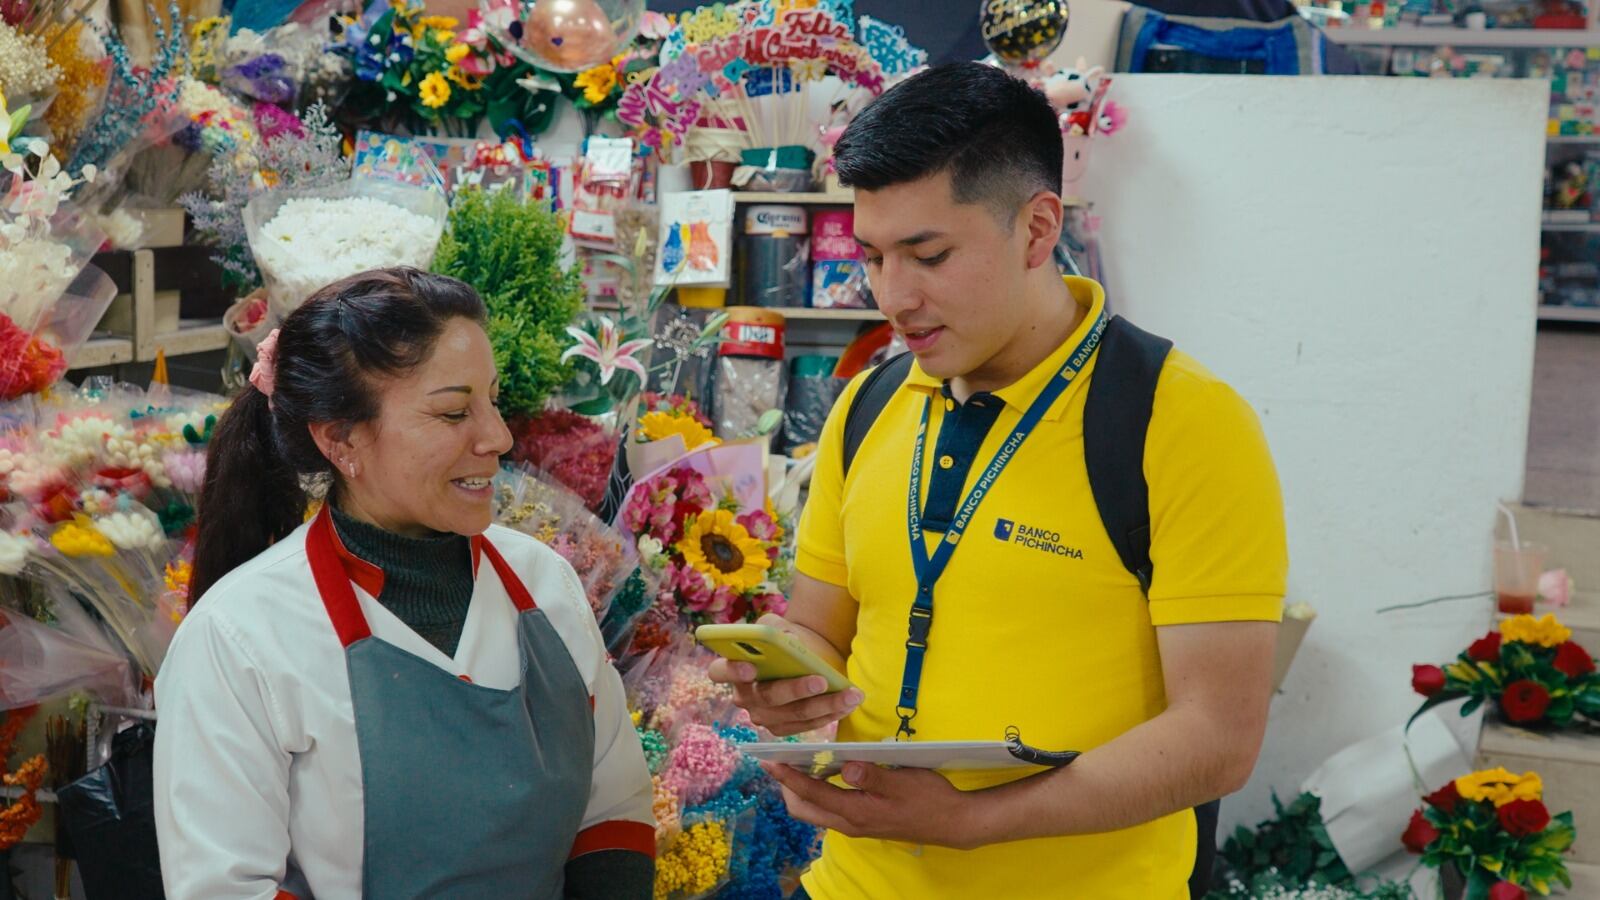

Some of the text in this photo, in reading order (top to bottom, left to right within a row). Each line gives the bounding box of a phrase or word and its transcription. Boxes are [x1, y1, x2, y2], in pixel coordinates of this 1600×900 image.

[784, 12, 850, 41] Feliz
[757, 212, 802, 227] Corona
[1073, 333, 1099, 367] BANCO
[910, 438, 923, 541] BANCO PICHINCHA
[955, 431, 1025, 529] BANCO PICHINCHA
[1015, 535, 1083, 560] PICHINCHA
[1018, 525, 1060, 542] BANCO
